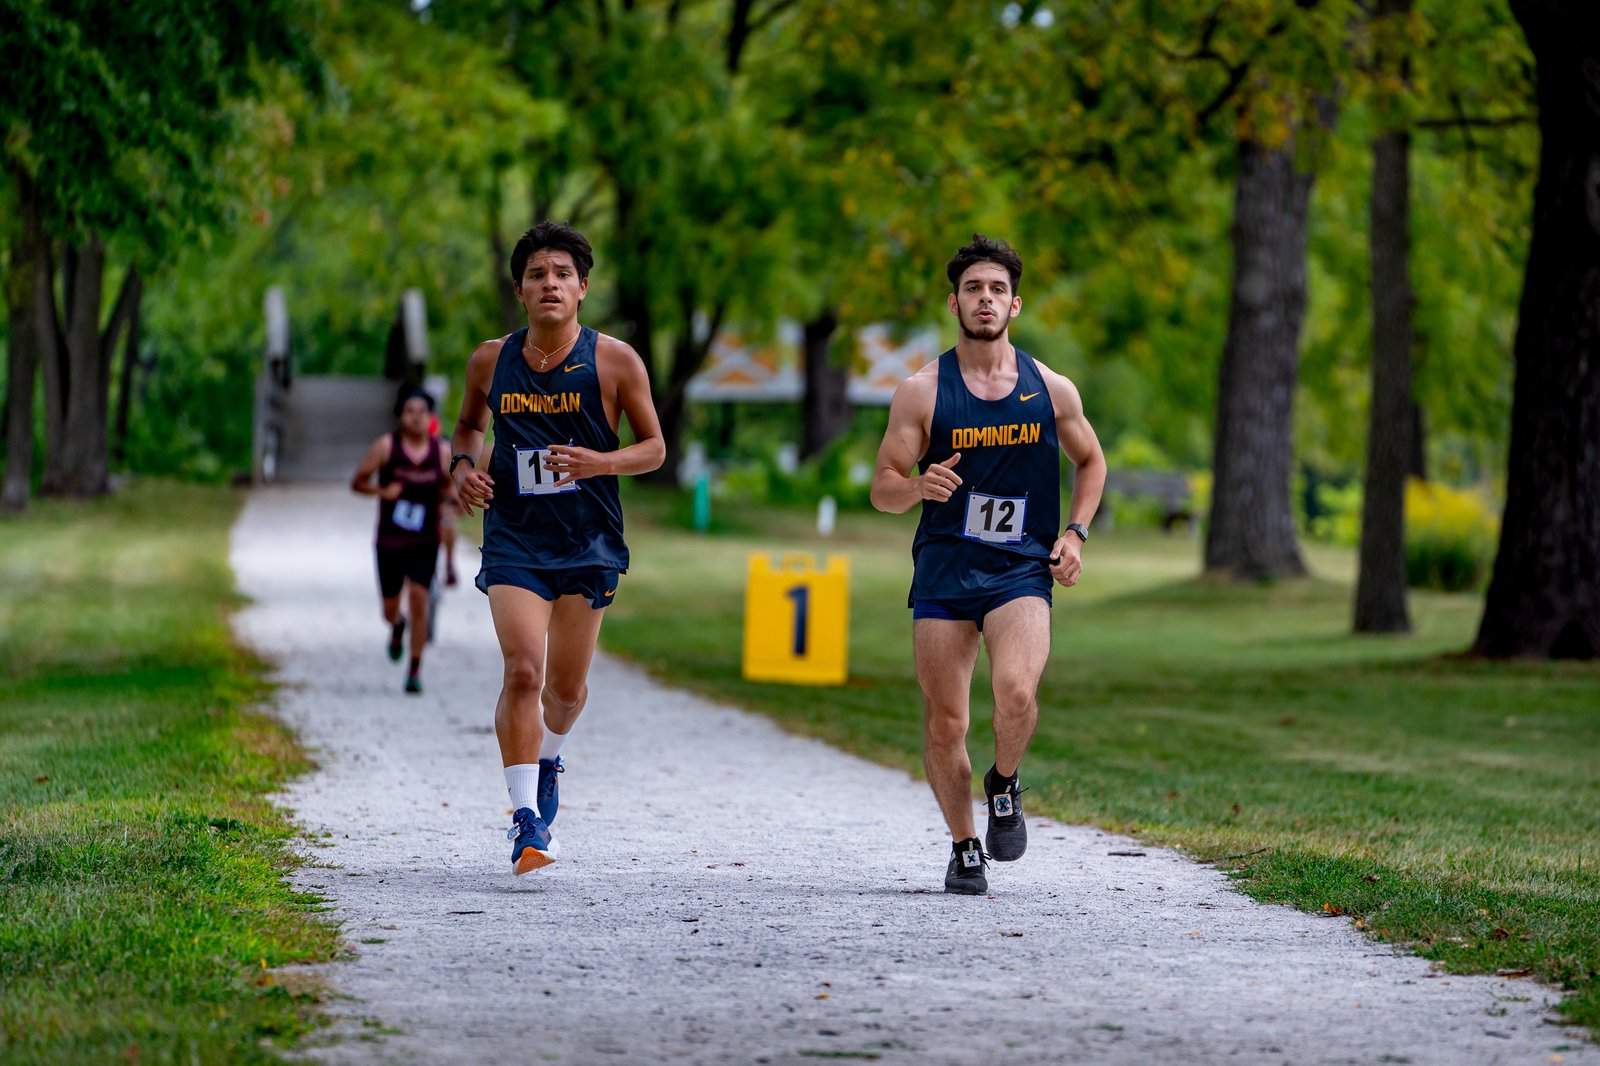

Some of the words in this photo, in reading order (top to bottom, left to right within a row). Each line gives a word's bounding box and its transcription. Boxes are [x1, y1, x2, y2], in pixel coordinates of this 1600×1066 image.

[501, 392, 581, 414] DOMINICAN
[952, 422, 1041, 449] DOMINICAN
[980, 498, 1015, 533] 12
[785, 584, 810, 657] 1
